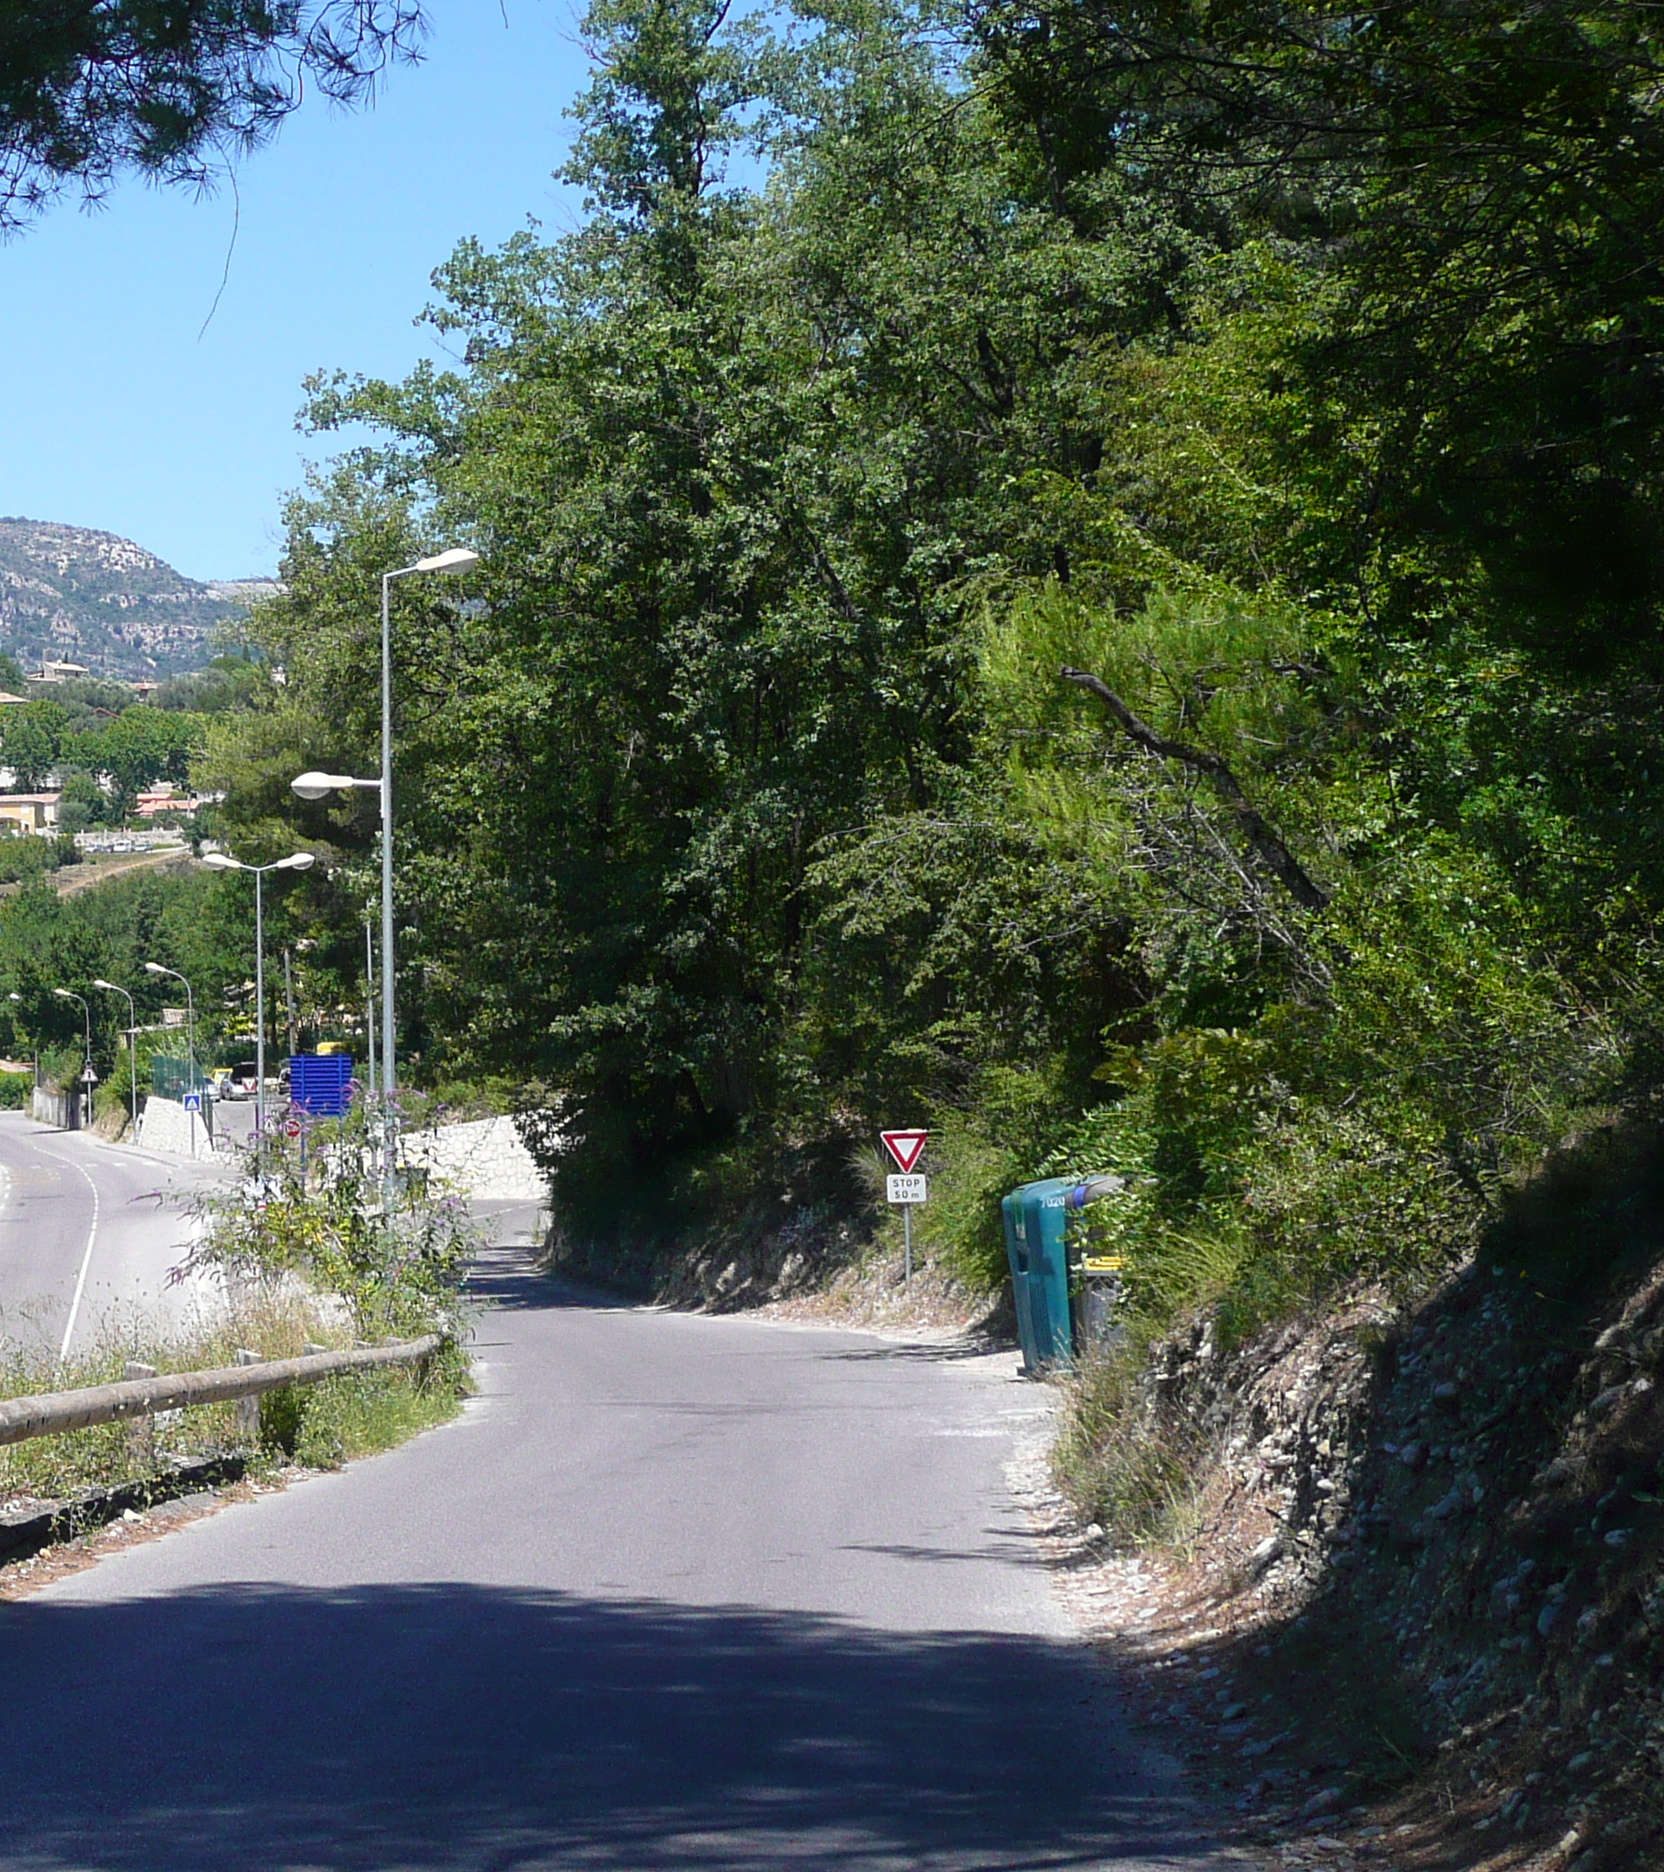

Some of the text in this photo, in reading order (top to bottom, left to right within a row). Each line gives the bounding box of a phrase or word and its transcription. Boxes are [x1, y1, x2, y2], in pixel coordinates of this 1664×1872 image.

[893, 1179, 920, 1187] STOP
[894, 1190, 920, 1199] 50 m
[1040, 1196, 1065, 1208] 7020
